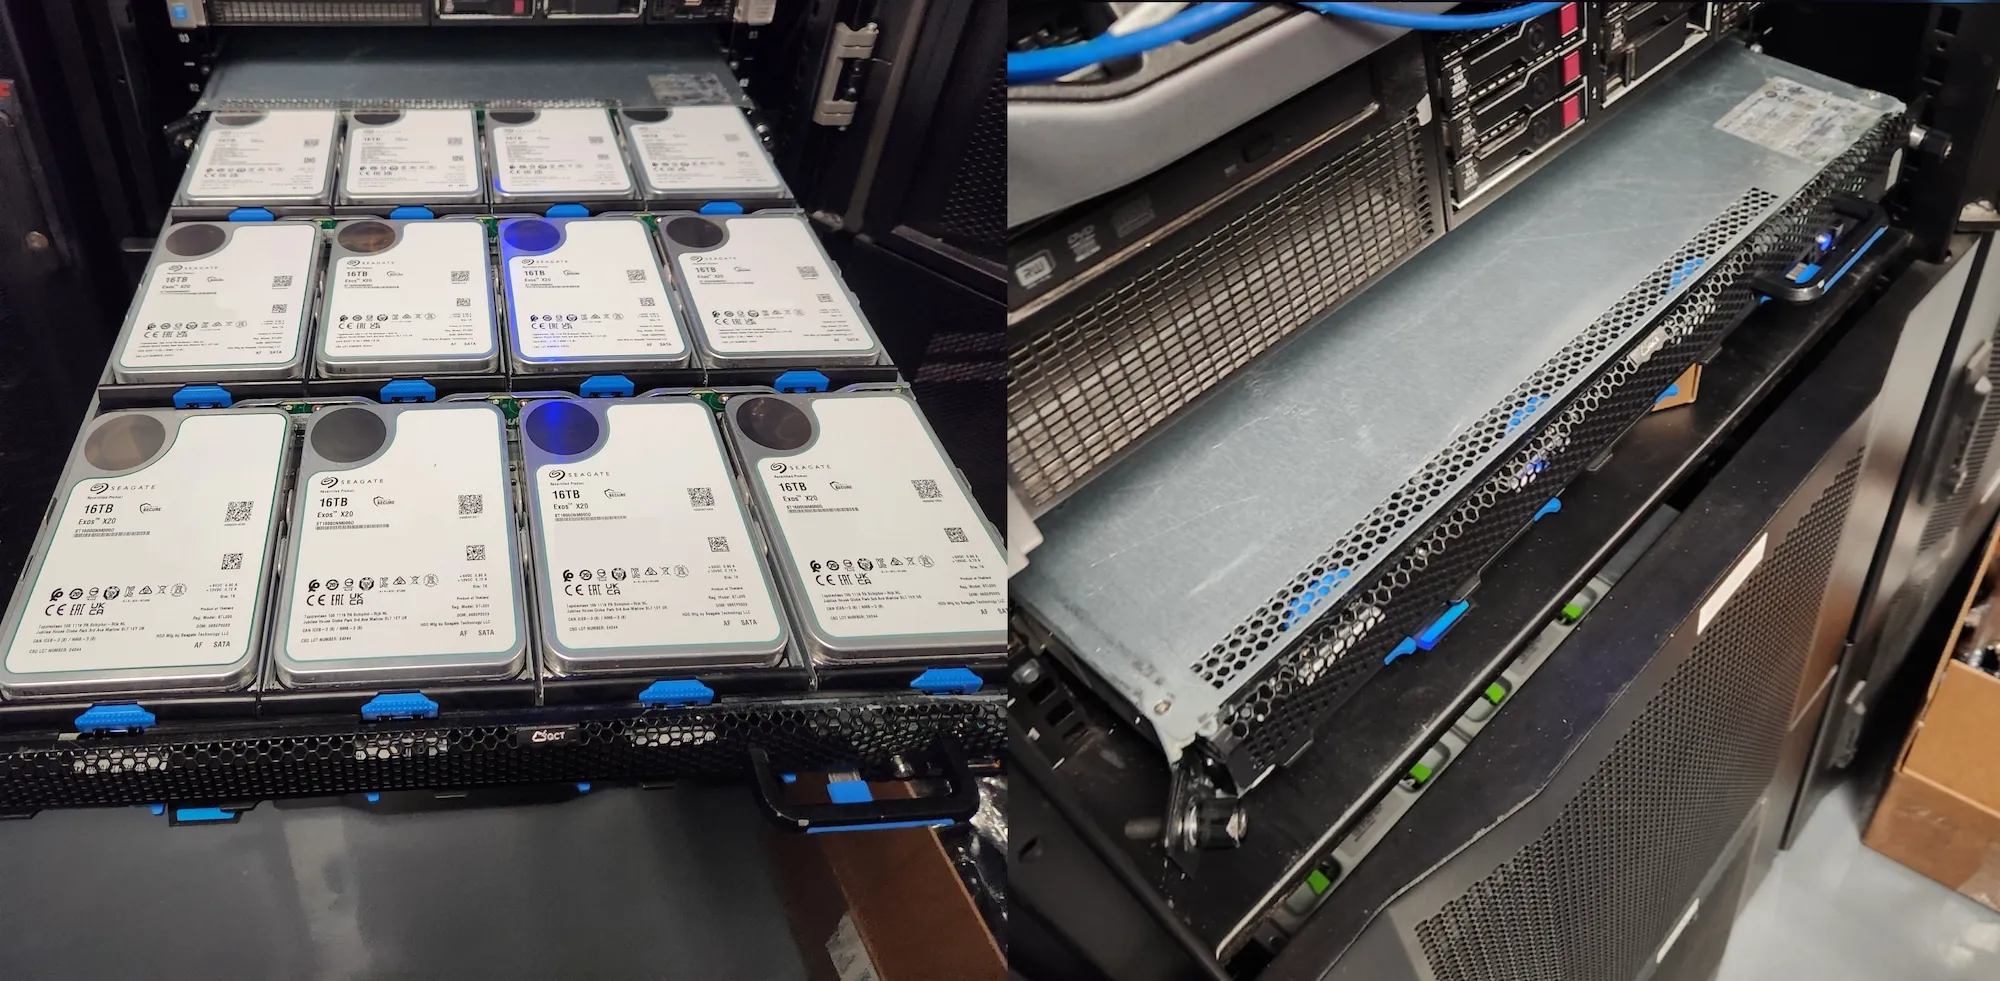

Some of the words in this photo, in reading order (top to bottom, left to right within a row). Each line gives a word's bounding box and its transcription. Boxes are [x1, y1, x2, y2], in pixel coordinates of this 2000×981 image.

[779, 482, 807, 492] 16TB
[552, 489, 580, 499] 16TB
[320, 497, 348, 507] 16TB
[84, 503, 114, 514] 16TB
[102, 517, 117, 525] X20
